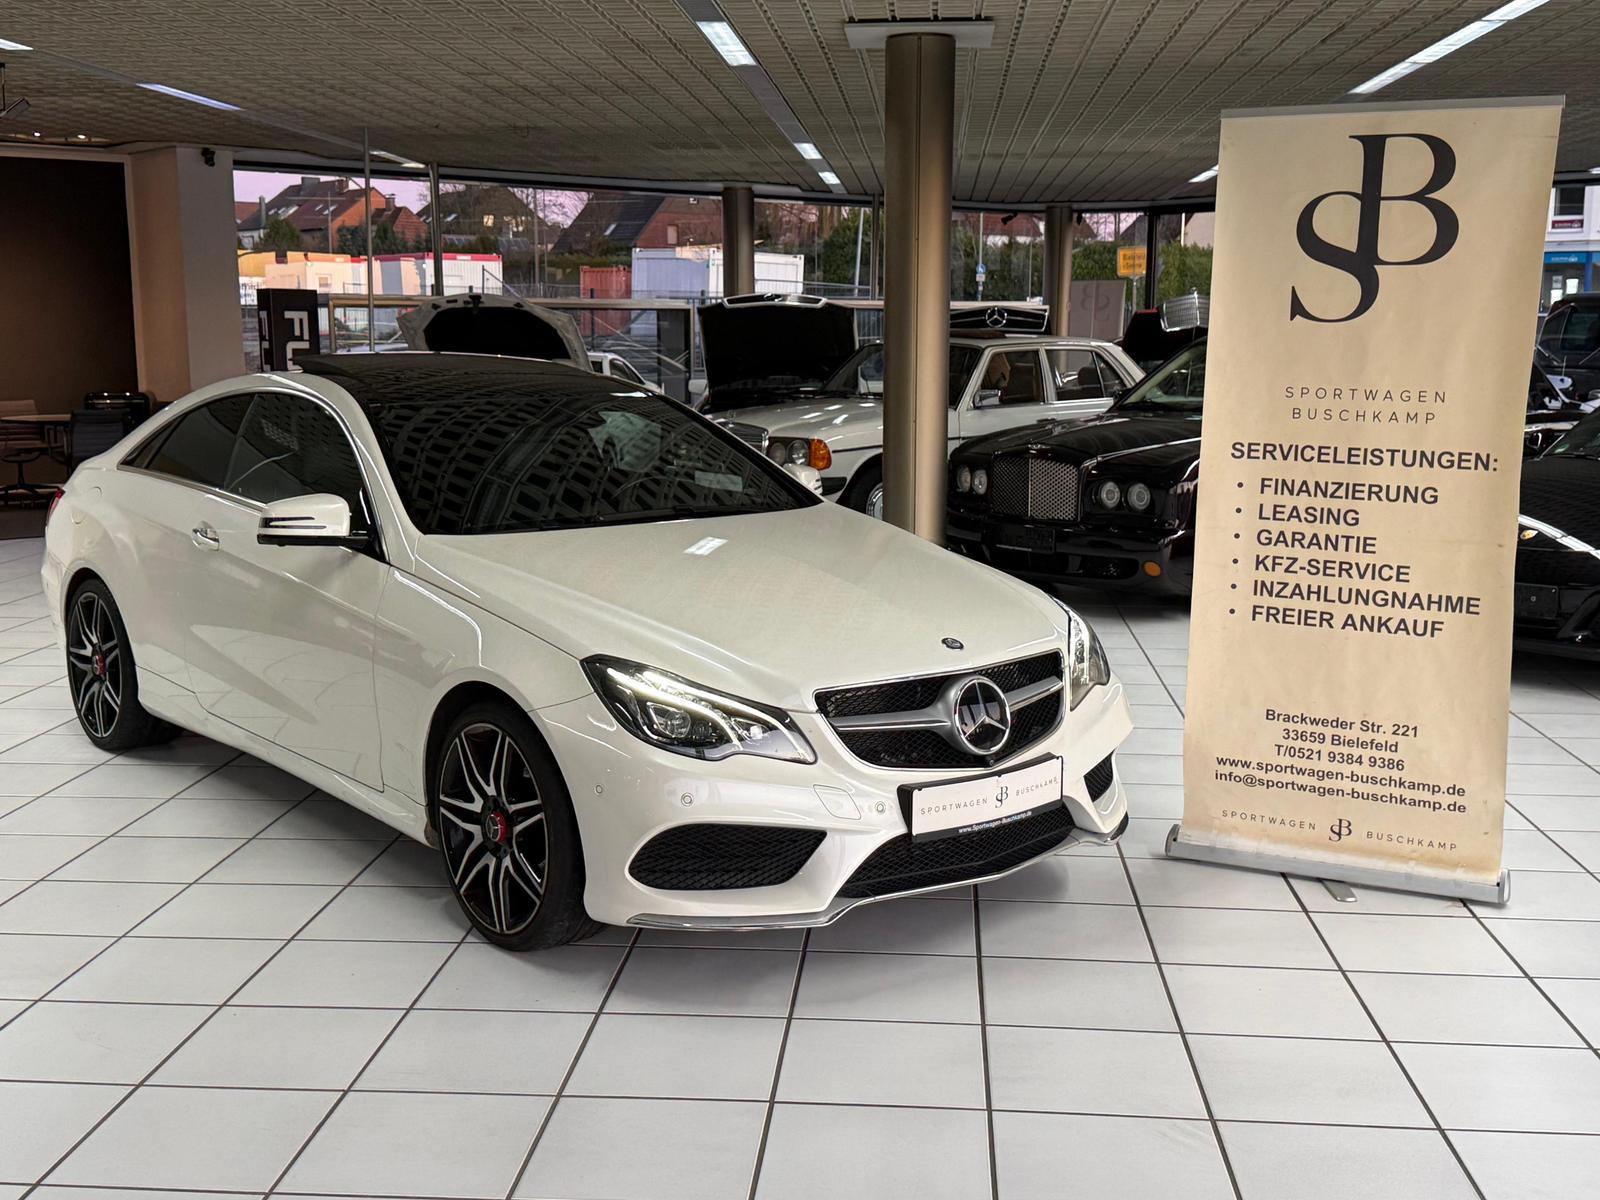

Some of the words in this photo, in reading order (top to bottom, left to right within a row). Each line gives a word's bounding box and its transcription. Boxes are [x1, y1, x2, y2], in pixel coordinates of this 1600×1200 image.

[1285, 386, 1447, 404] SPORTWAGEN
[1292, 407, 1436, 425] BUSCHKAMP
[1230, 441, 1498, 472] SERVICELEISTUNGEN:
[1259, 477, 1439, 505] FINANZIERUNG
[1258, 502, 1360, 527] LEASING
[1256, 528, 1377, 555] GARANTIE
[1254, 553, 1411, 584] KFZ-SERVICE
[1252, 579, 1481, 616] INZAHLUNGNAHME
[1251, 604, 1335, 630] FREIER
[1340, 613, 1445, 638] ANKAUF
[1265, 708, 1356, 731] Brackweder
[1359, 719, 1387, 735] Str.
[1391, 723, 1418, 738] 221
[1282, 727, 1326, 745] 33659
[1330, 733, 1399, 754] Bielefeld
[1274, 743, 1322, 762] T/0521
[1327, 750, 1364, 767] 9384
[1368, 755, 1405, 772] 9386
[1214, 769, 1467, 814] info@sportwagen-buschkamp.de
[1215, 756, 1466, 798] www.sportwagen-buschkamp.de
[920, 797, 988, 815] SPORTWAGEN
[1221, 809, 1317, 831] SPORTWAGEN
[1366, 830, 1457, 852] BUSCHKAMP
